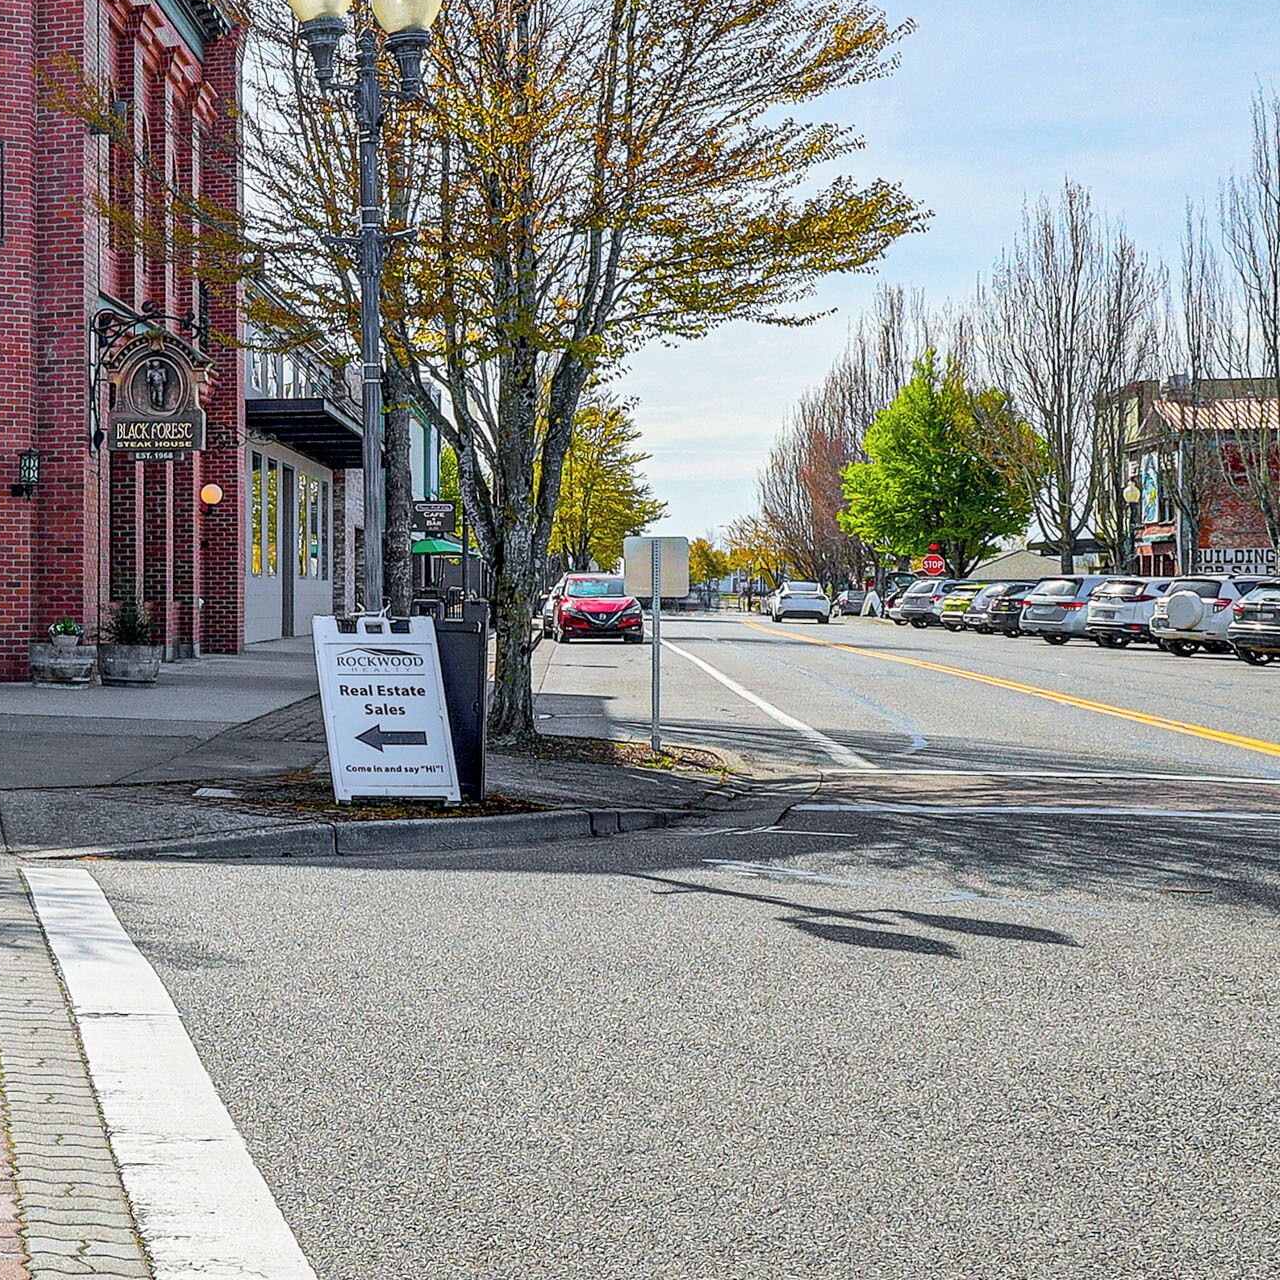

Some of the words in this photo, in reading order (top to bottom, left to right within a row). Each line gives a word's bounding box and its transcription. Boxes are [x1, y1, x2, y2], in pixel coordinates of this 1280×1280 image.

[116, 422, 149, 439] BLACK
[151, 422, 194, 439] FOREST
[135, 452, 152, 460] EST.
[923, 560, 943, 569] STOP
[336, 656, 424, 667] ROCKWOOD
[339, 684, 374, 697] Real
[377, 685, 426, 697] Estate
[364, 703, 406, 716] Sales
[345, 764, 372, 773] Come
[384, 765, 402, 773] and
[404, 766, 420, 775] say
